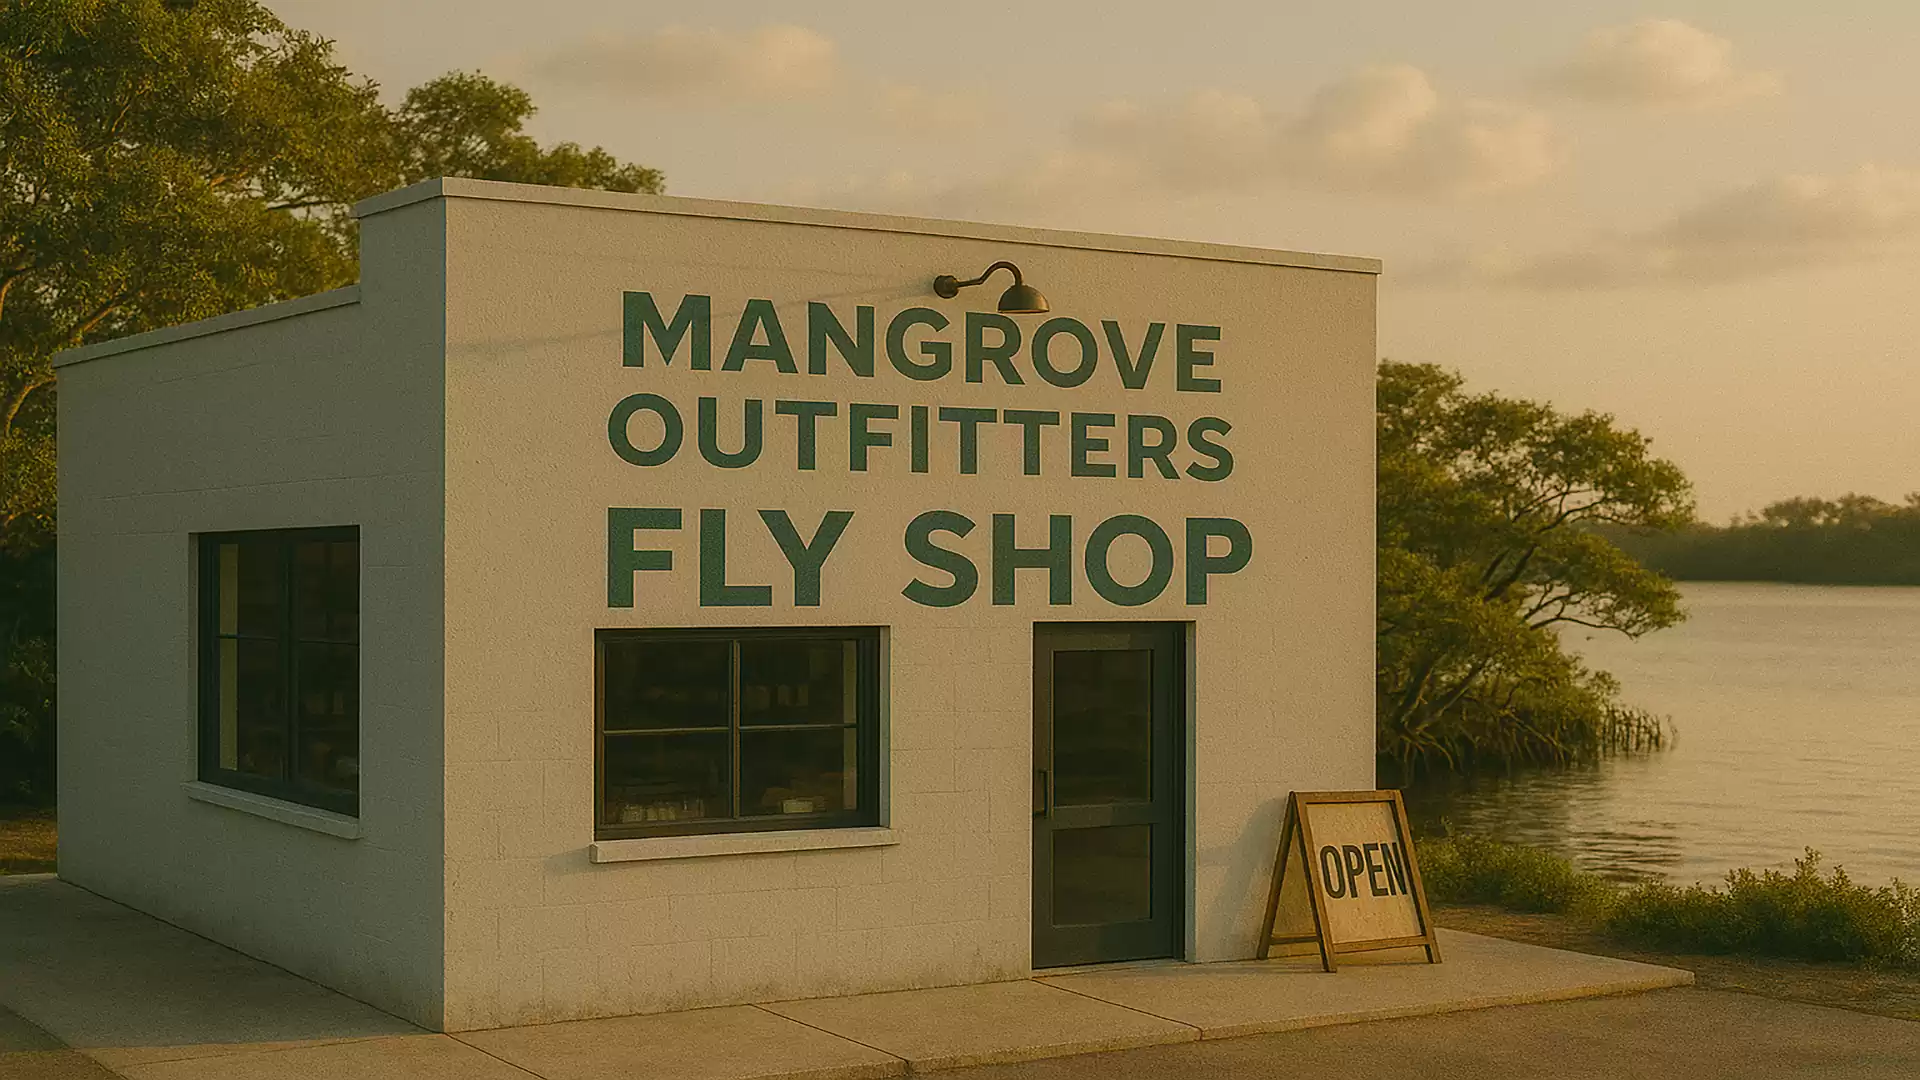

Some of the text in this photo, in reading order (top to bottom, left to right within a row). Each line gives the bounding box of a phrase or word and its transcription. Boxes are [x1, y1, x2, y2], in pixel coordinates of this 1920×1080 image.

[622, 291, 1222, 393] MANGROVE
[608, 393, 1234, 482] OUTFITTERS
[607, 507, 1253, 608] FLY SHOP
[1319, 842, 1408, 899] OPEN
